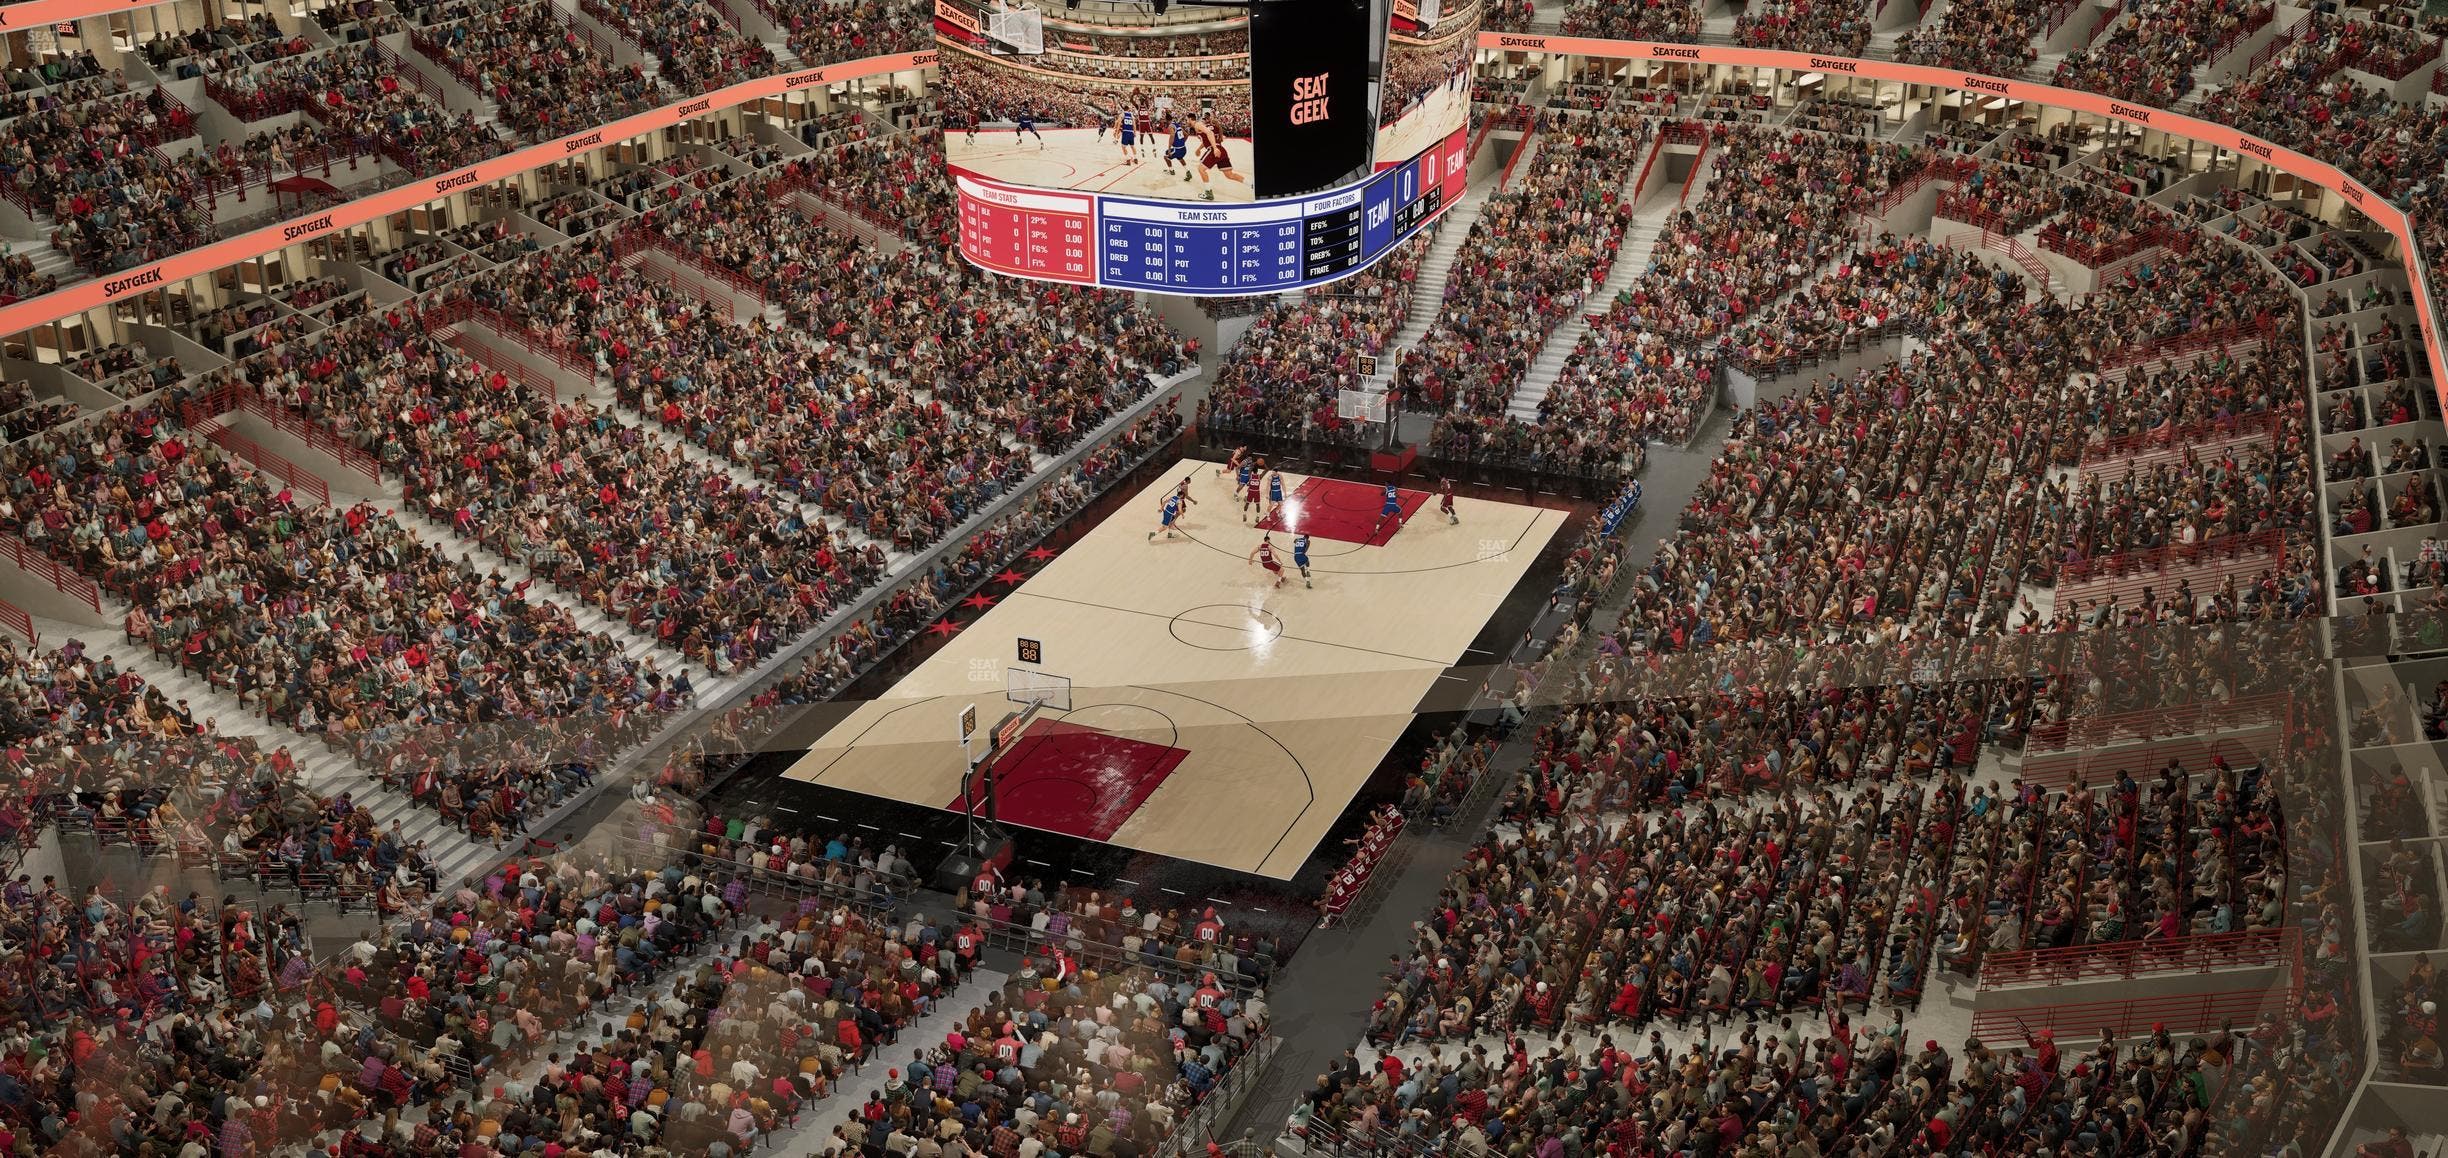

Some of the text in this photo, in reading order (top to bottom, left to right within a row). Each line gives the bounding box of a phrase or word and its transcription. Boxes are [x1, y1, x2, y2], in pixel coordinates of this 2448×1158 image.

[1396, 0, 1415, 18] SEATGEEK
[940, 4, 976, 31] SEATGEEK
[58, 25, 74, 34] GEEK
[1500, 36, 1545, 49] SEATGEEK
[1652, 46, 1700, 59] SEATGEEK
[912, 55, 939, 66] SEATG
[1810, 58, 1857, 73] SEATGEEK
[786, 71, 824, 88] SEATGEEK
[1293, 72, 1328, 101] SEAT
[1965, 76, 2009, 94] SEATGEEK
[678, 97, 710, 118] SEATGEEK
[1290, 97, 1329, 125] GEEK
[2110, 103, 2150, 123] SEATGEEK
[565, 131, 602, 153] SEATGEEK
[2239, 137, 2273, 161] SEATGEEK
[1447, 147, 1464, 177] TEAM
[1428, 154, 1435, 185] 0
[436, 170, 478, 194] SEATGEEK
[1404, 169, 1411, 202] 0
[982, 189, 1018, 204] TEAM STATS
[2342, 180, 2364, 206] SEATGEEK
[1314, 193, 1355, 212] FOUR FACTORS
[1412, 198, 1425, 219] 0:00
[981, 207, 1019, 223] BLK 0
[1178, 211, 1228, 221] TEAM STATS
[1310, 210, 1360, 231] EFG% 0.00
[1367, 198, 1390, 231] TEAM
[284, 214, 333, 241] SEATGEEK
[1030, 216, 1082, 230] 2P% 0.00
[1013, 228, 1019, 237] 0
[1031, 231, 1083, 244] 3P% 0.00
[1109, 224, 1162, 238] AST 0.00
[1175, 231, 1228, 241] BLK 0
[1242, 226, 1296, 239] 2P% 0.00
[1310, 225, 1359, 246] TO% 0.00
[1014, 243, 1020, 251] 0
[1031, 245, 1083, 258] FG% 0.00
[1110, 239, 1163, 252] OREB 0.00
[1175, 245, 1228, 255] TO 0
[1242, 241, 1296, 253] 3P% 0.00
[1310, 240, 1359, 261] OREB% 0.00
[1014, 257, 1020, 265] 0
[1066, 262, 1083, 272] 0.00
[1110, 253, 1163, 267] DREB 0.00
[1175, 260, 1228, 270] POT 0
[1242, 255, 1295, 268] FG% 0.00
[1310, 255, 1358, 276] FTRATE 0.00
[1110, 267, 1163, 281] STL 0.00
[1175, 274, 1228, 284] STL 0
[1278, 270, 1295, 280] 0.00
[104, 267, 162, 298] SEATGEEK
[1020, 640, 1039, 650] 88 88
[1022, 648, 1037, 661] 88
[979, 879, 991, 892] 00
[1343, 874, 1355, 885] 00
[1201, 927, 1214, 940] 00
[958, 935, 970, 949] 00
[1200, 994, 1214, 1008] 00
[999, 1044, 1013, 1058] 00
